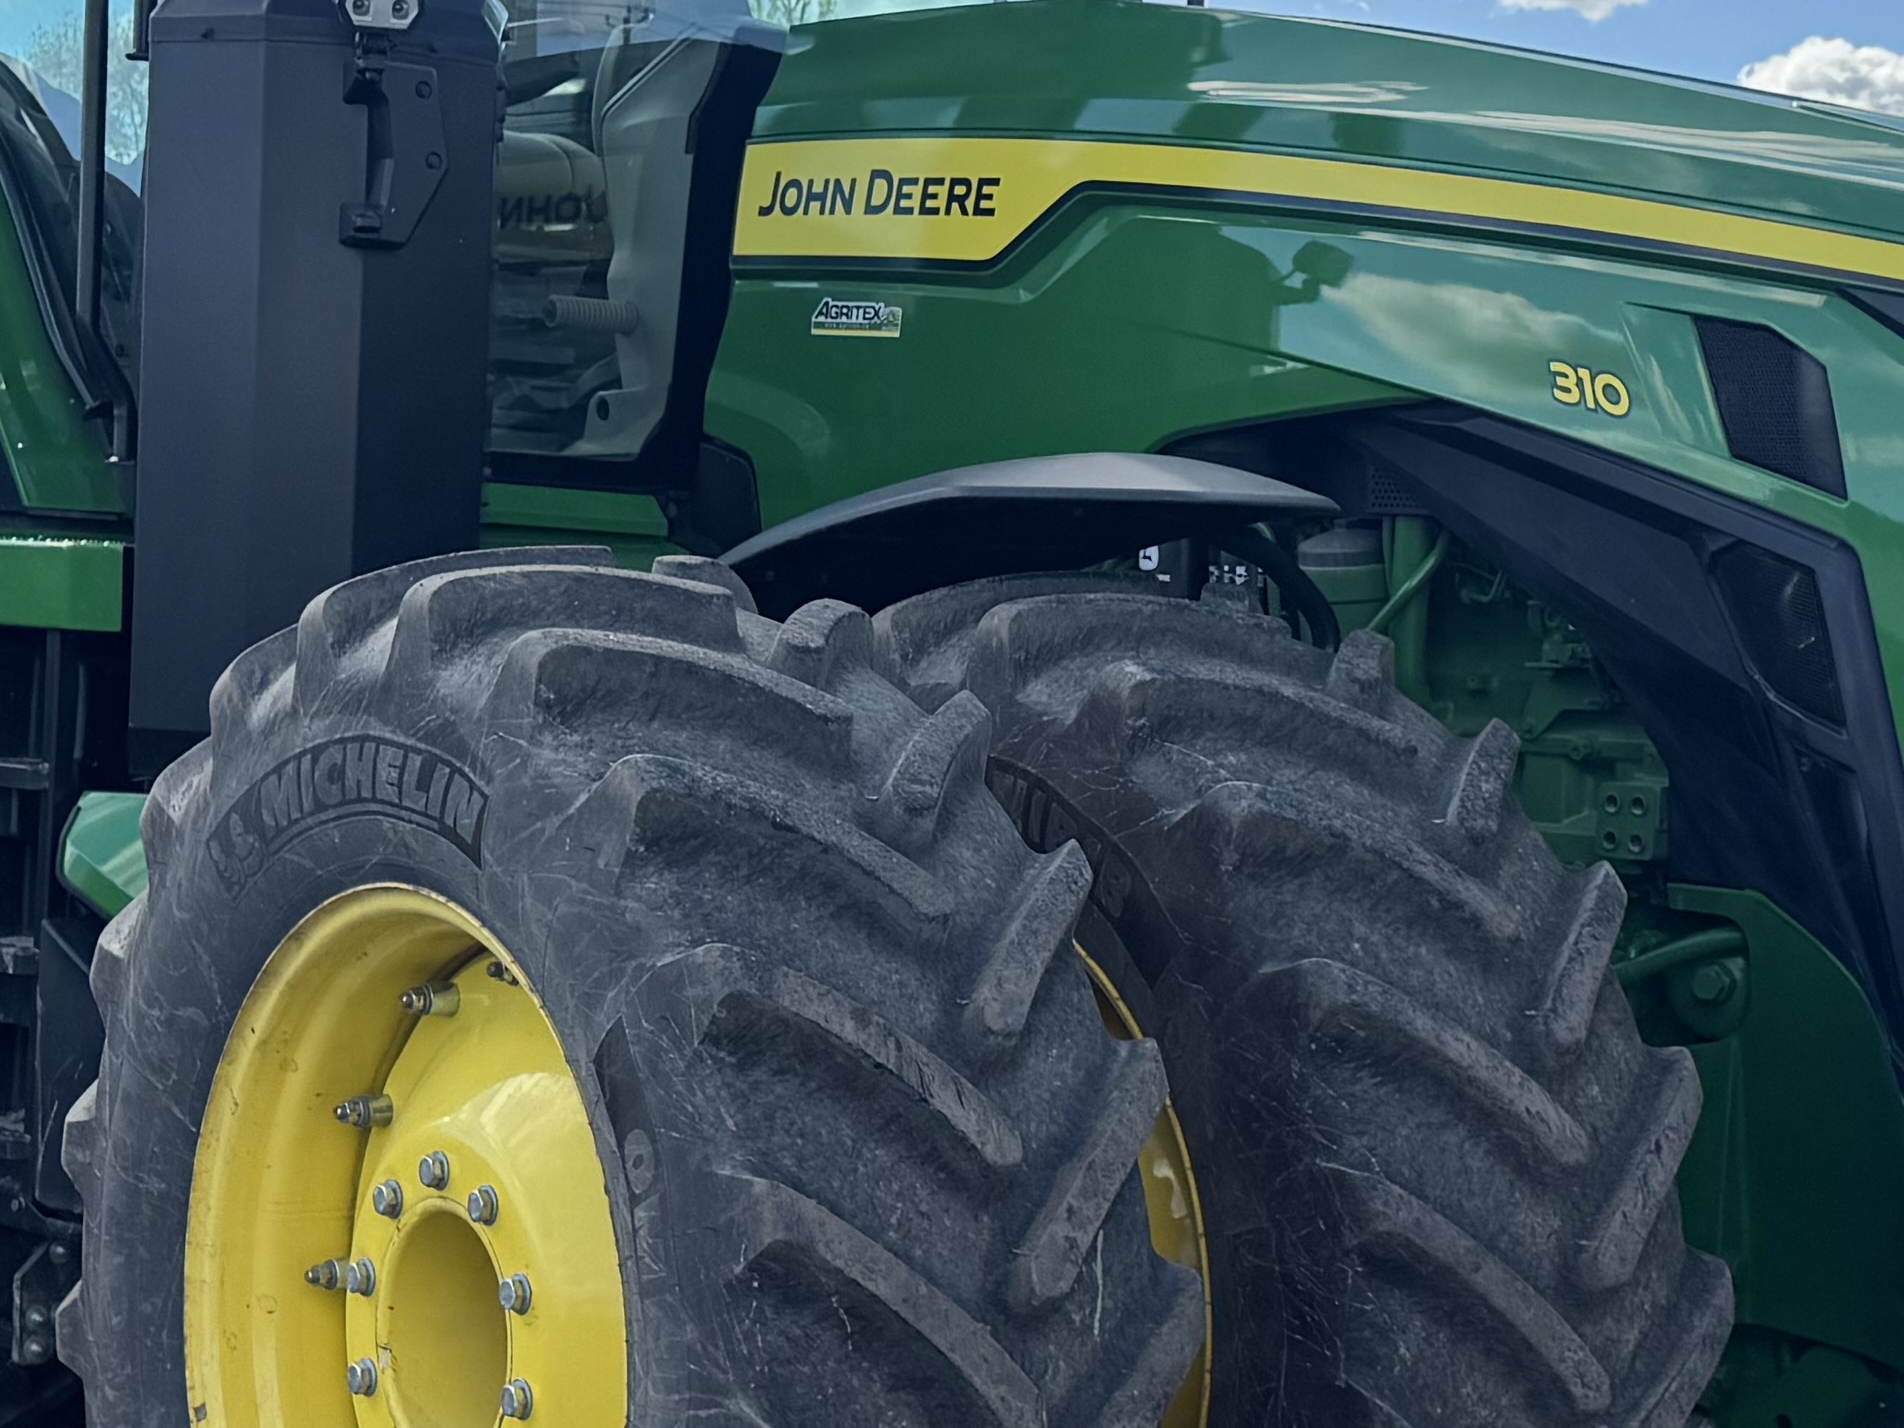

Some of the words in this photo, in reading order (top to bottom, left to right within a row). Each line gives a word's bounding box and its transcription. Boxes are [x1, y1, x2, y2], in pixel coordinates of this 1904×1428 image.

[758, 170, 857, 217] JOHN
[863, 168, 1001, 217] DEERE
[814, 300, 882, 321] AGRITEX
[1549, 360, 1630, 417] 310
[260, 741, 486, 840] MICHELIN
